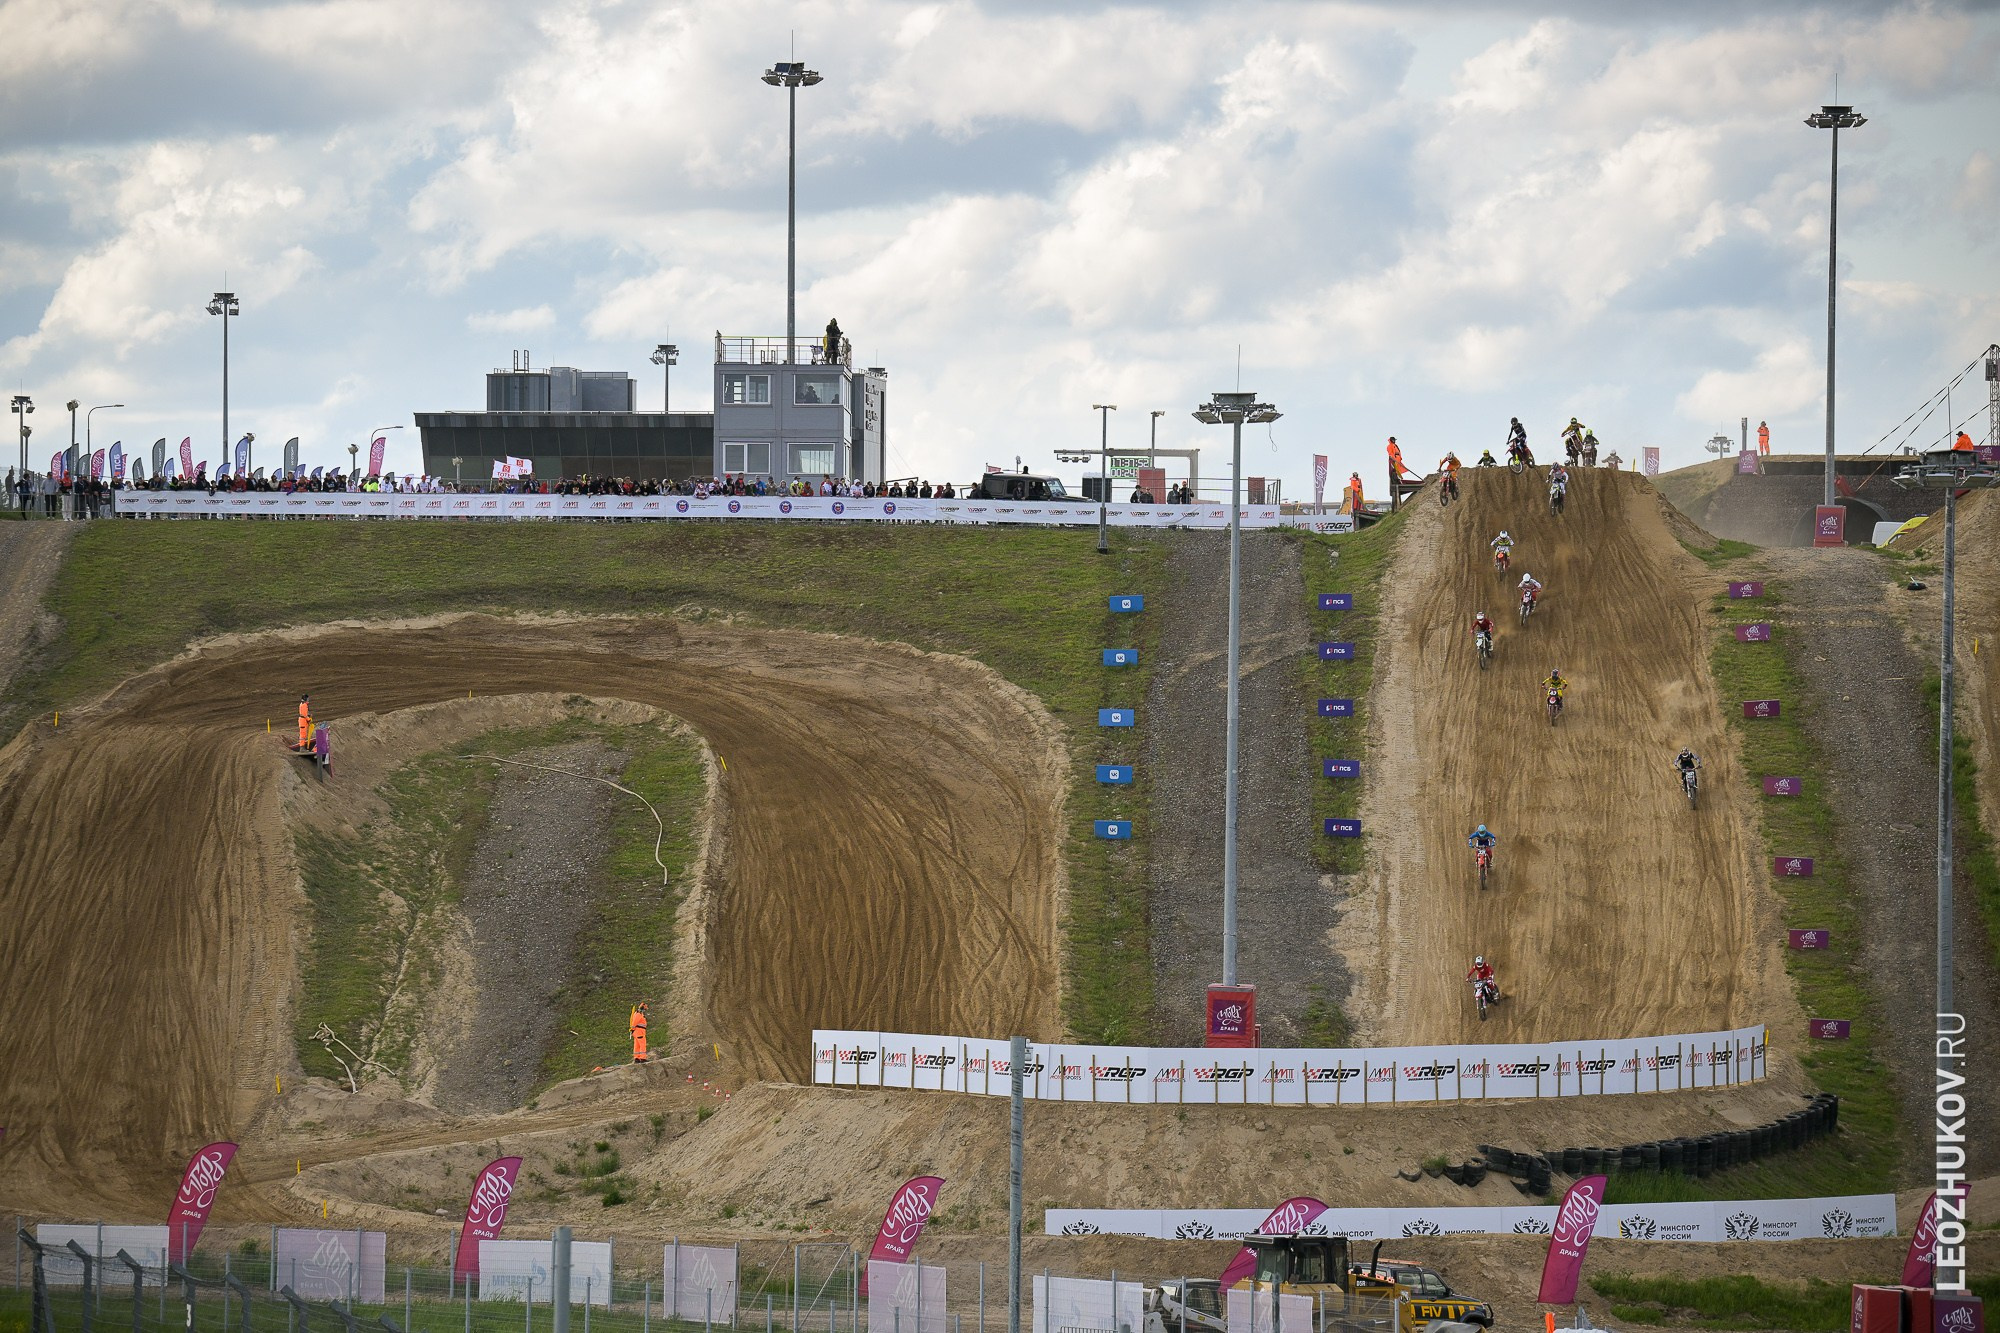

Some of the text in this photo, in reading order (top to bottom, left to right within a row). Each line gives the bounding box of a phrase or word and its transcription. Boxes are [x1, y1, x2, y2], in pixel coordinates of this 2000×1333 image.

[1112, 458, 1149, 467] 17:37:52
[849, 1051, 877, 1061] RGP
[924, 1055, 956, 1065] RGP
[1658, 1054, 1682, 1066] RGP
[1512, 1064, 1550, 1074] RGP
[1586, 1060, 1615, 1070] RGP
[1104, 1067, 1146, 1077] RGP
[1210, 1068, 1254, 1078] RGP
[1318, 1068, 1360, 1079] RGP
[1418, 1065, 1455, 1076] RGP
[182, 1209, 201, 1218] ДРАЙВ
[473, 1229, 493, 1238] ДРАЙВ
[885, 1244, 904, 1254] ДРАЙВ
[1421, 1306, 1442, 1317] FIV
